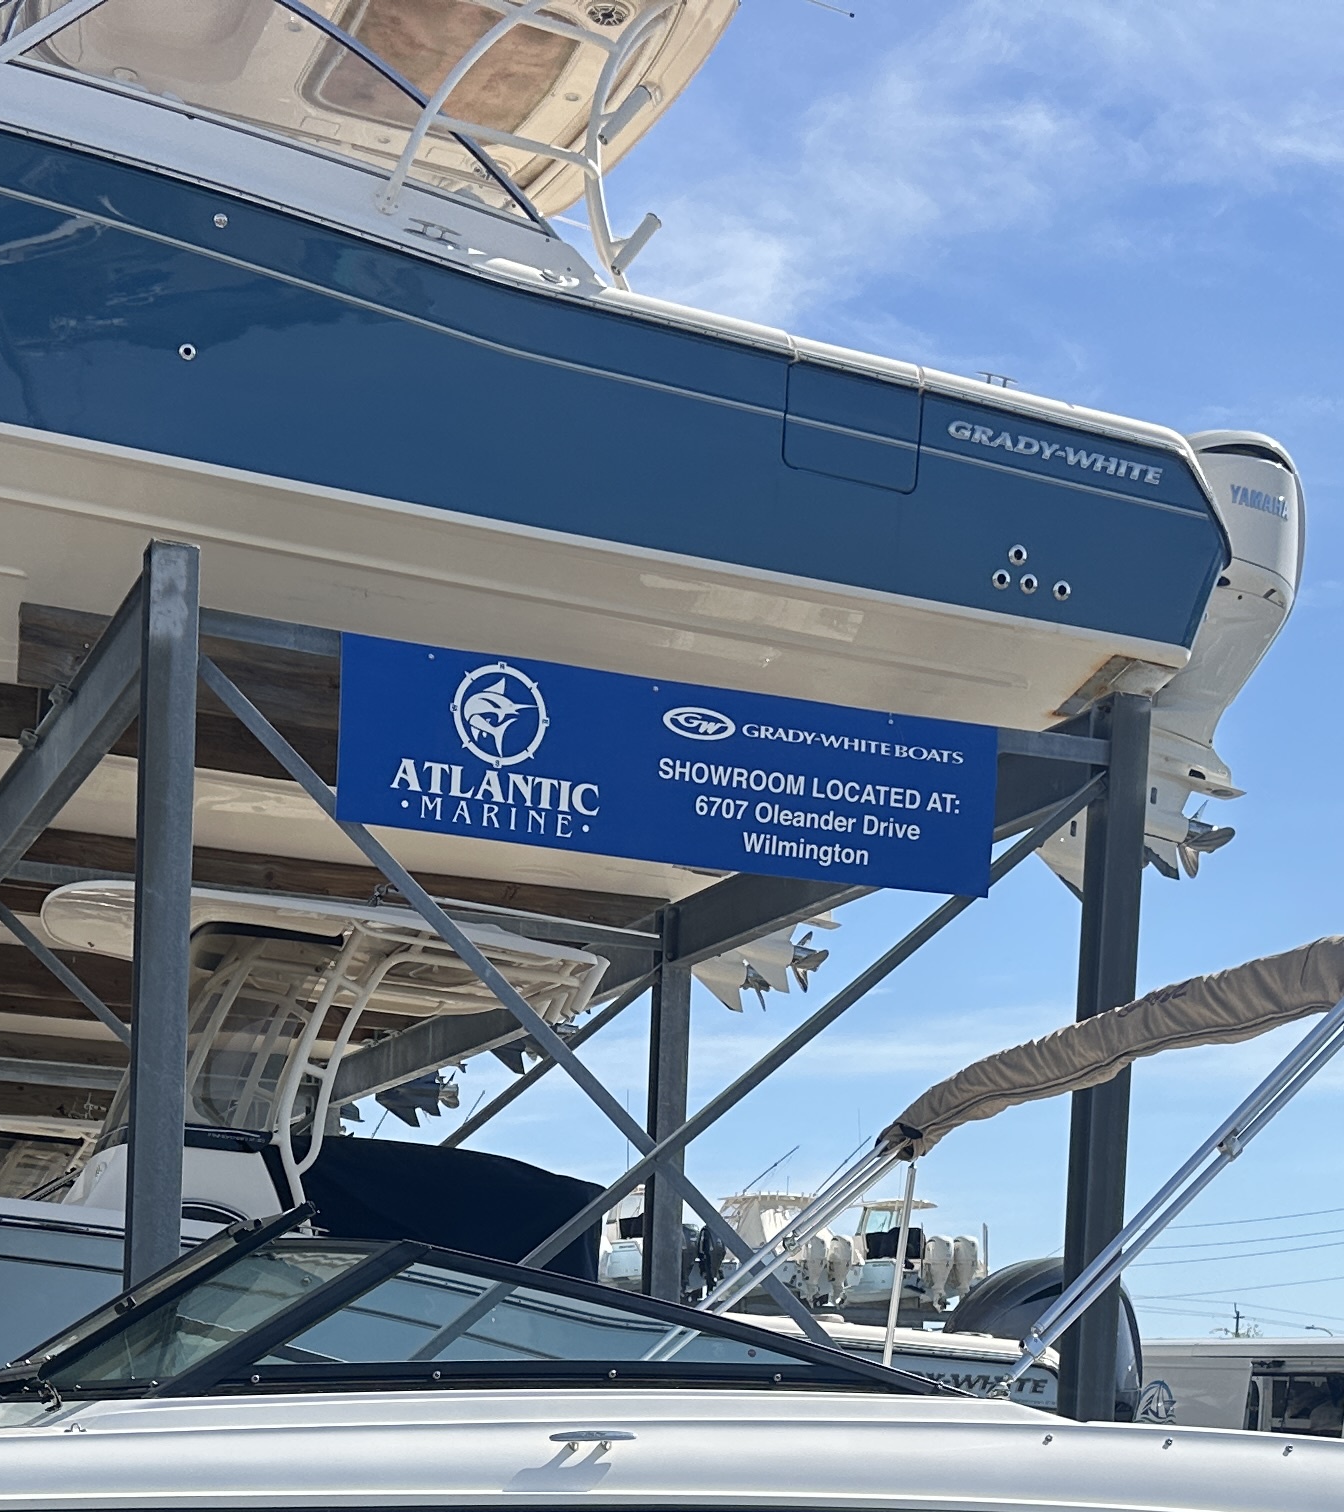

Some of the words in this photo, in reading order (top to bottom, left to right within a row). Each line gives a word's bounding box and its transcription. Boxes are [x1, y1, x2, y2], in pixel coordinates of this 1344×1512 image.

[947, 420, 1164, 486] GRADY-WHITE
[1230, 484, 1288, 521] YAMAHA
[668, 710, 731, 736] GW
[742, 724, 891, 756] GRADY-WHITE
[894, 744, 964, 765] BOATS
[390, 758, 600, 816] ATLANTIC
[658, 757, 805, 796] SHOWROOM
[812, 777, 921, 810] LOCATED
[926, 792, 961, 815] AT:
[420, 795, 573, 838] MARINE
[695, 795, 749, 821] 6707
[754, 802, 857, 833] Oleander
[863, 817, 921, 841] Drive
[743, 831, 869, 866] Wilmington
